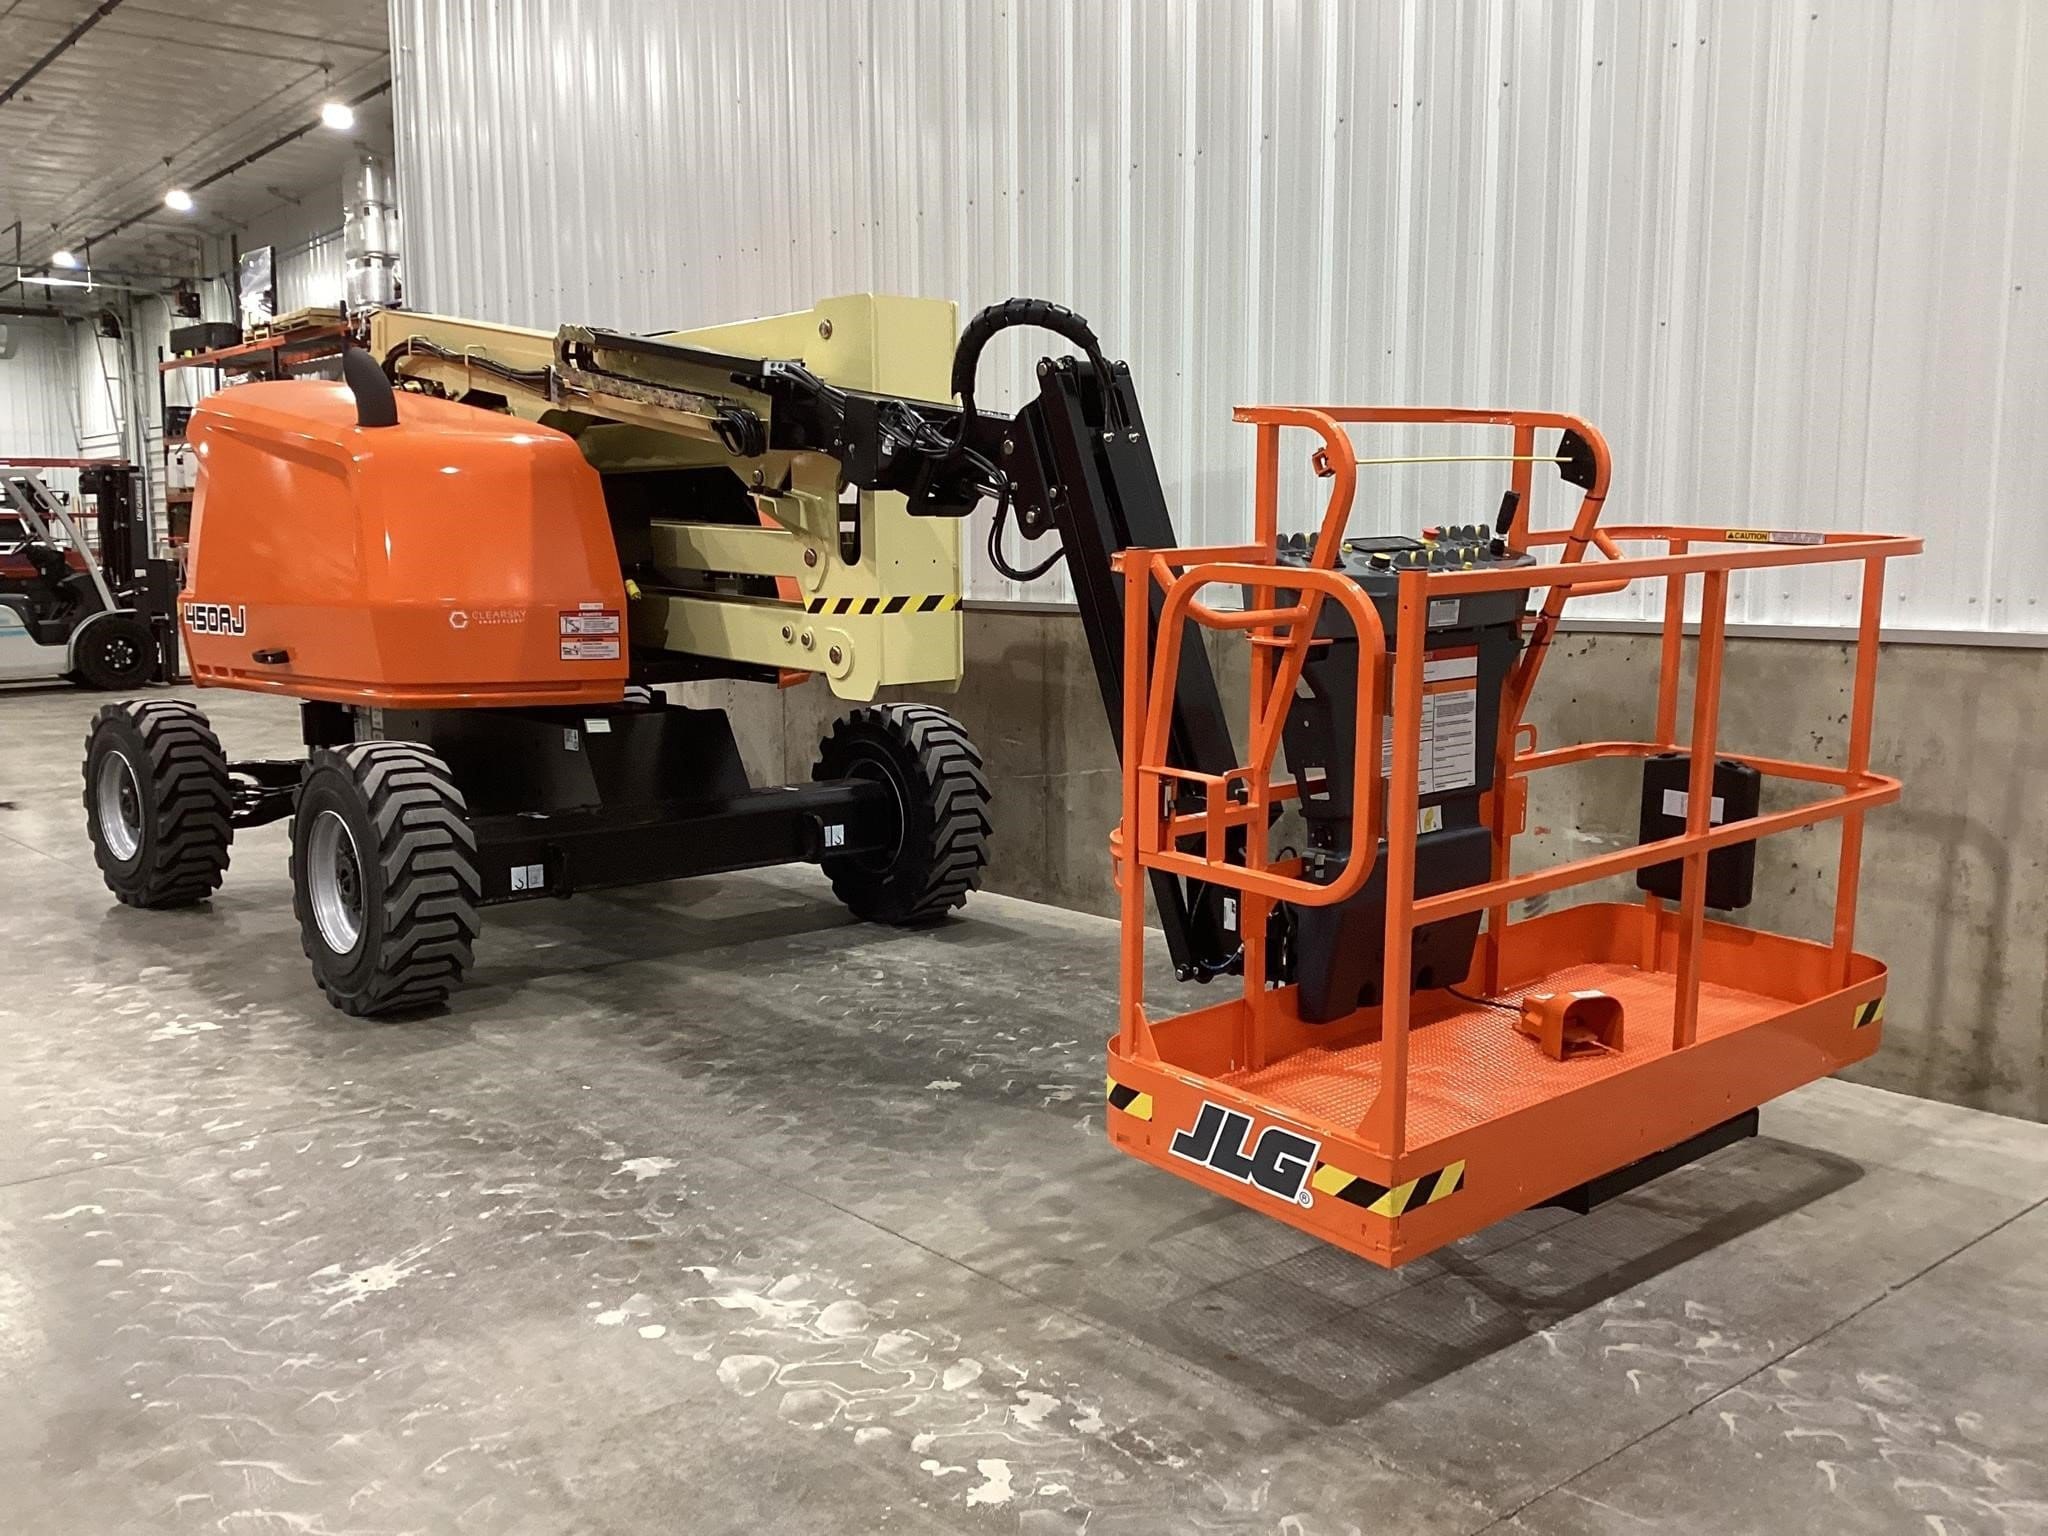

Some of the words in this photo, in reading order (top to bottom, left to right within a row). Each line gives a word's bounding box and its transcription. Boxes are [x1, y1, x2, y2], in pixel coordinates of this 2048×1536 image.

[1734, 532, 1768, 540] CAUTION
[184, 603, 246, 636] 450AJ
[471, 610, 527, 620] CLEARSKY
[1169, 1101, 1320, 1203] JLG
